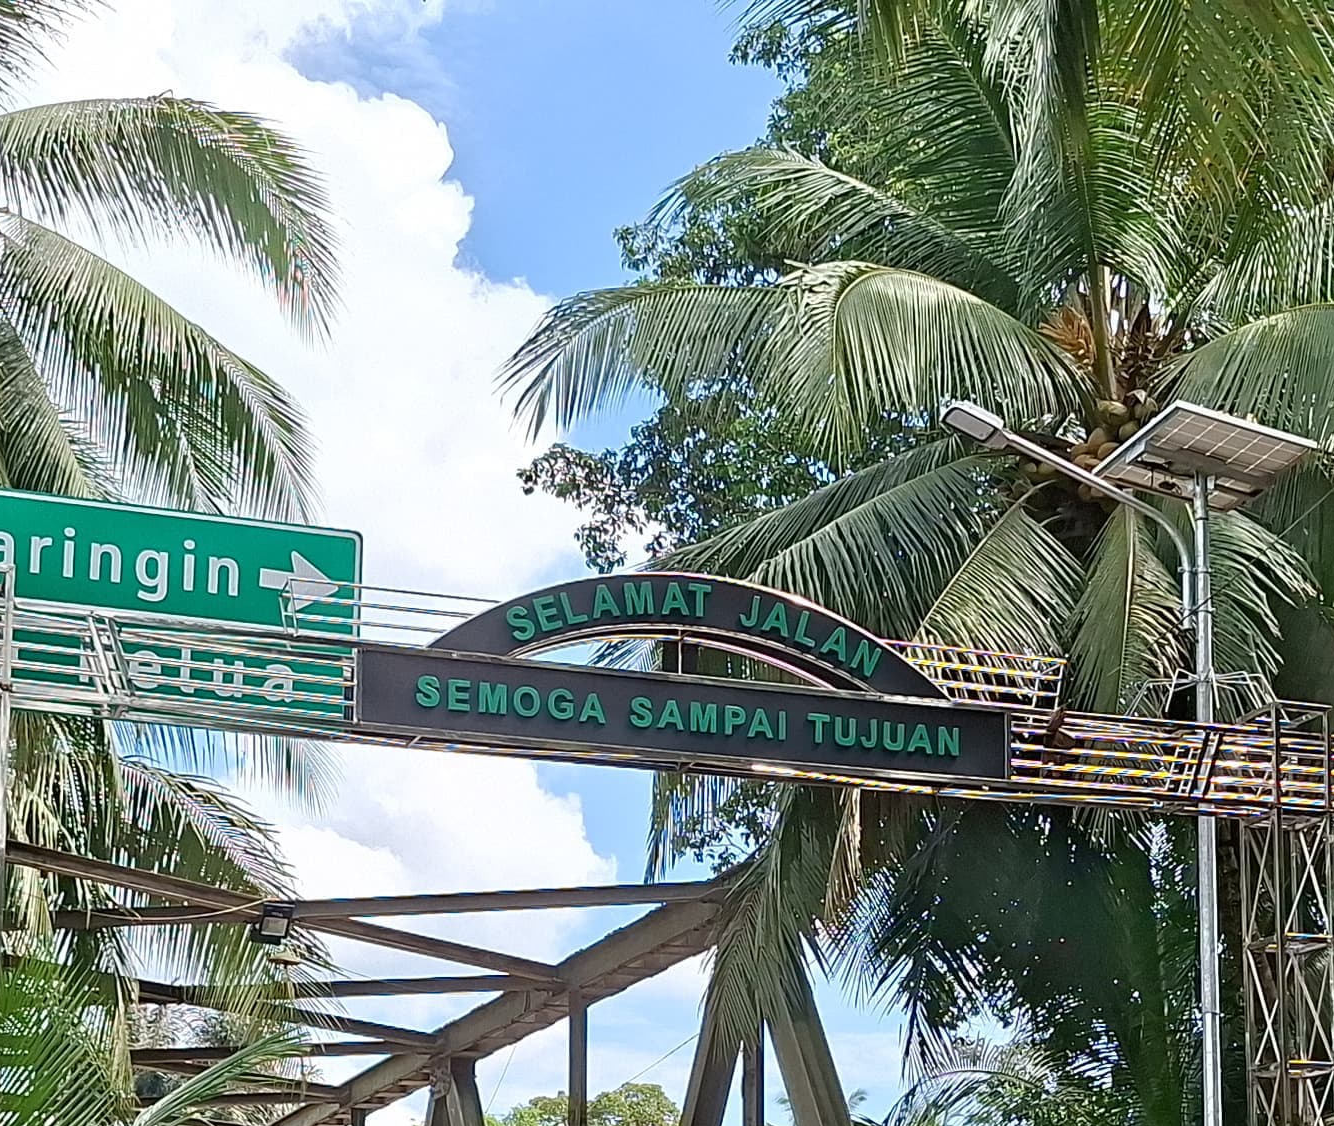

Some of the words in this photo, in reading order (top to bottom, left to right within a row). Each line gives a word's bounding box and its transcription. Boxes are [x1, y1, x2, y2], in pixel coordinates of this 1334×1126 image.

[507, 582, 712, 643] SELAMAT
[739, 594, 882, 679] JALAN
[416, 675, 606, 725] SEMOGA
[629, 696, 787, 742] SAMPAI
[807, 712, 960, 757] TUJUAN
